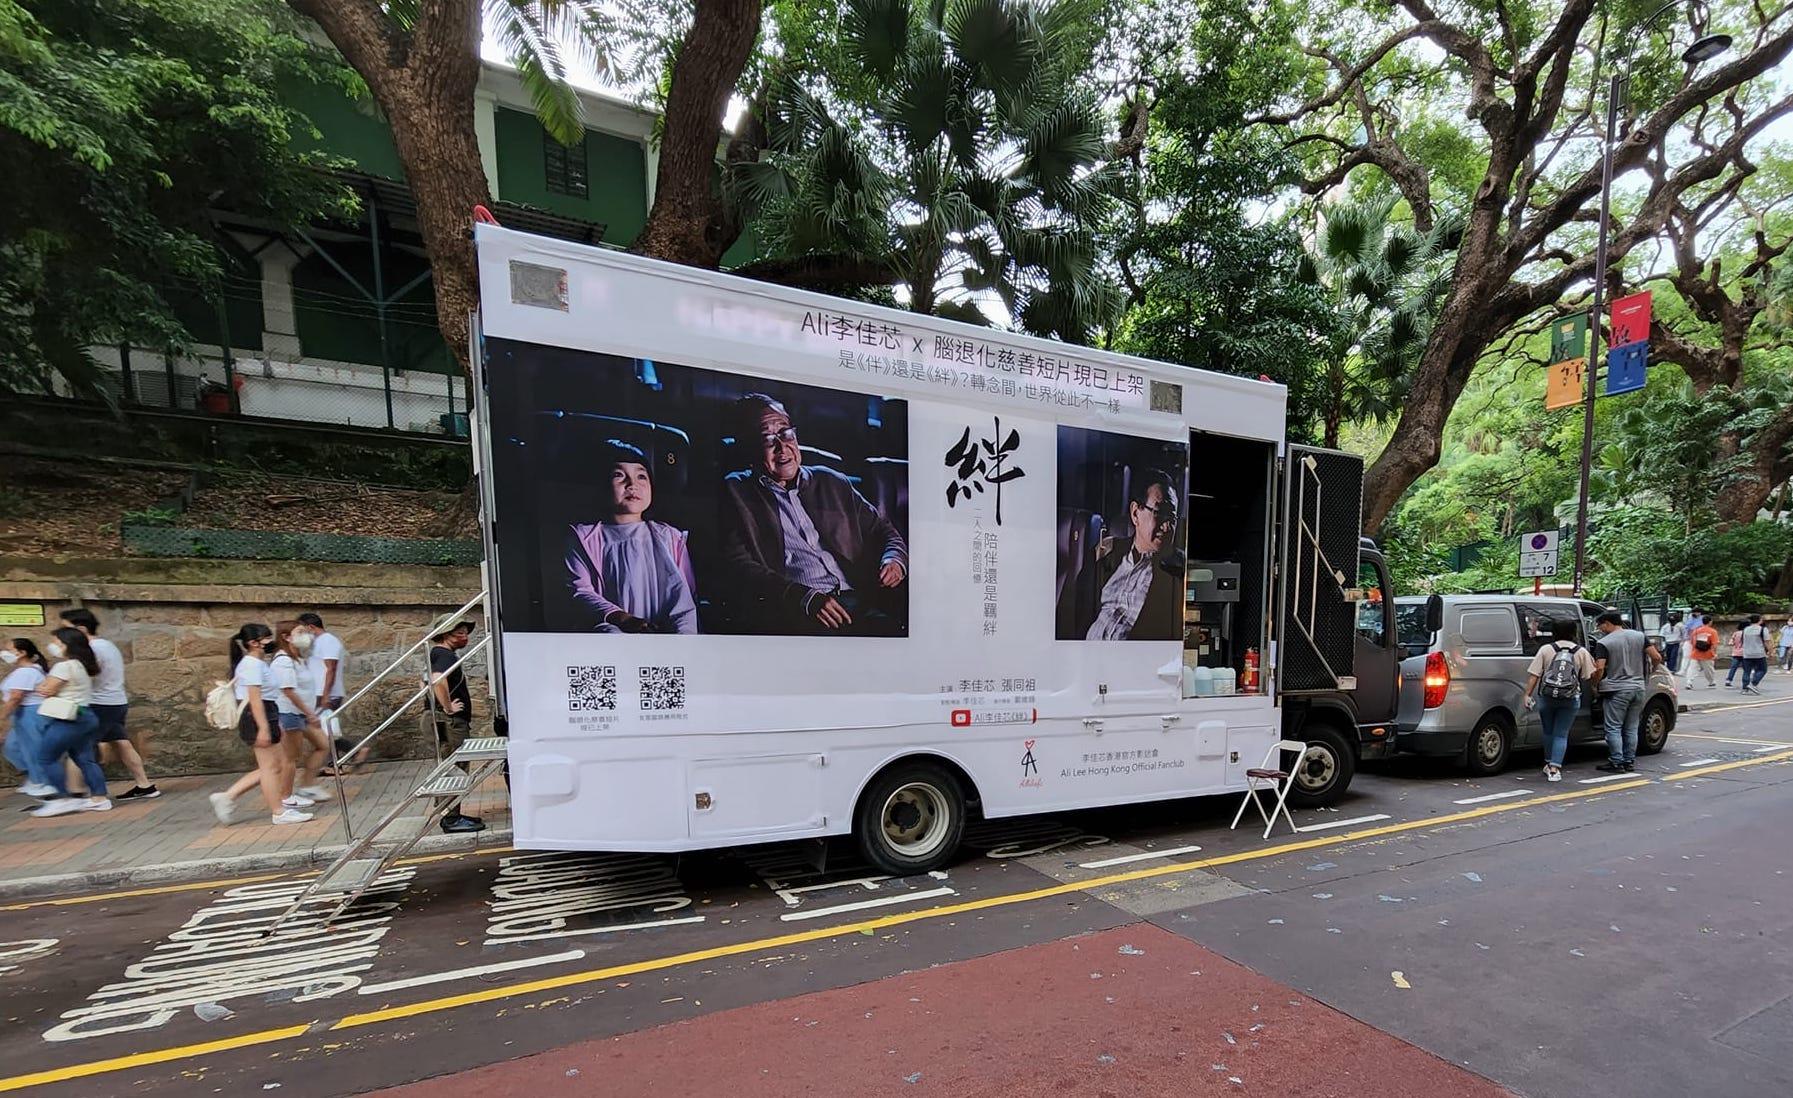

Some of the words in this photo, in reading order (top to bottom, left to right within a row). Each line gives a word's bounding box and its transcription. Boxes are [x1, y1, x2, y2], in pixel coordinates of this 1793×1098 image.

[801, 312, 901, 350] Ali李佳芯
[934, 335, 1144, 396] 腦退化慈善短片現已上架
[667, 452, 675, 464] 8
[945, 416, 1026, 526] 絆
[1543, 553, 1550, 561] 7
[1543, 566, 1555, 574] 12
[983, 532, 998, 637] 陪伴還是羈絆
[960, 680, 995, 692] 李佳芯
[1001, 678, 1036, 692] 張同祖
[1060, 768, 1071, 777] Ali
[1073, 768, 1086, 777] Lee
[1088, 767, 1109, 776] Hong
[1111, 765, 1130, 774] Kong
[1132, 762, 1157, 771] Official
[1158, 759, 1185, 769] Fanclub
